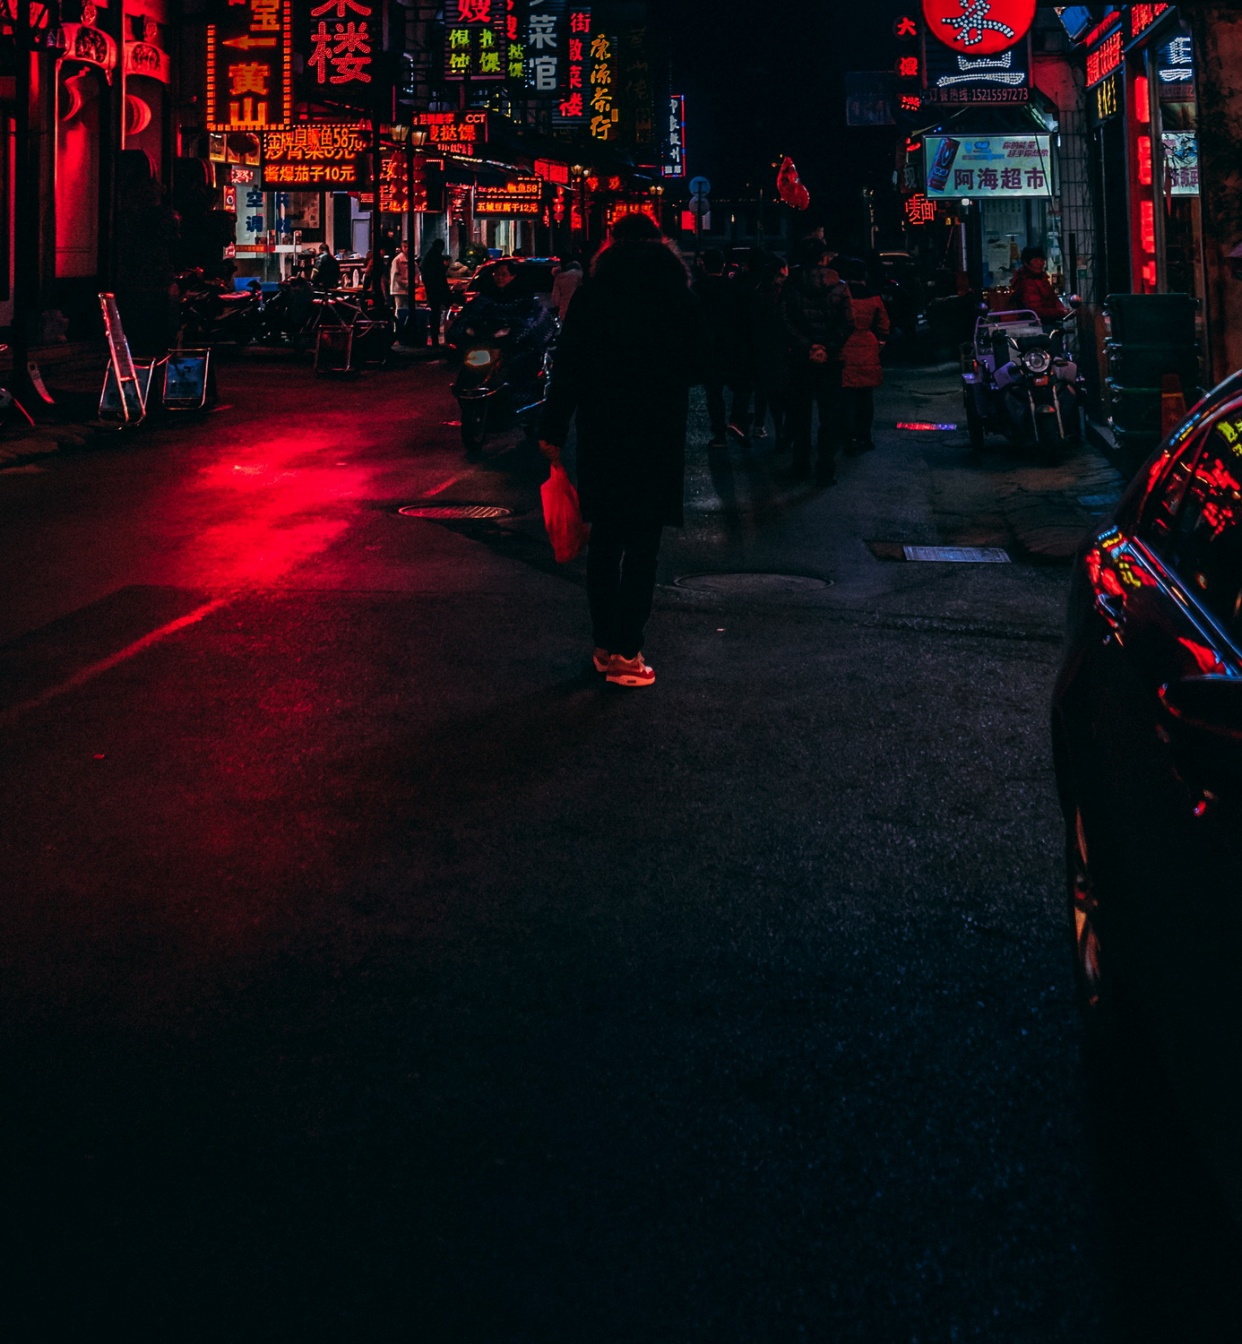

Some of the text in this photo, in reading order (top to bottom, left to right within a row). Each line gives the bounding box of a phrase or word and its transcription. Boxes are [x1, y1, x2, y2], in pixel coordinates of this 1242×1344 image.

[227, 61, 271, 128] 黄山
[954, 167, 1045, 191] 阿海超市
